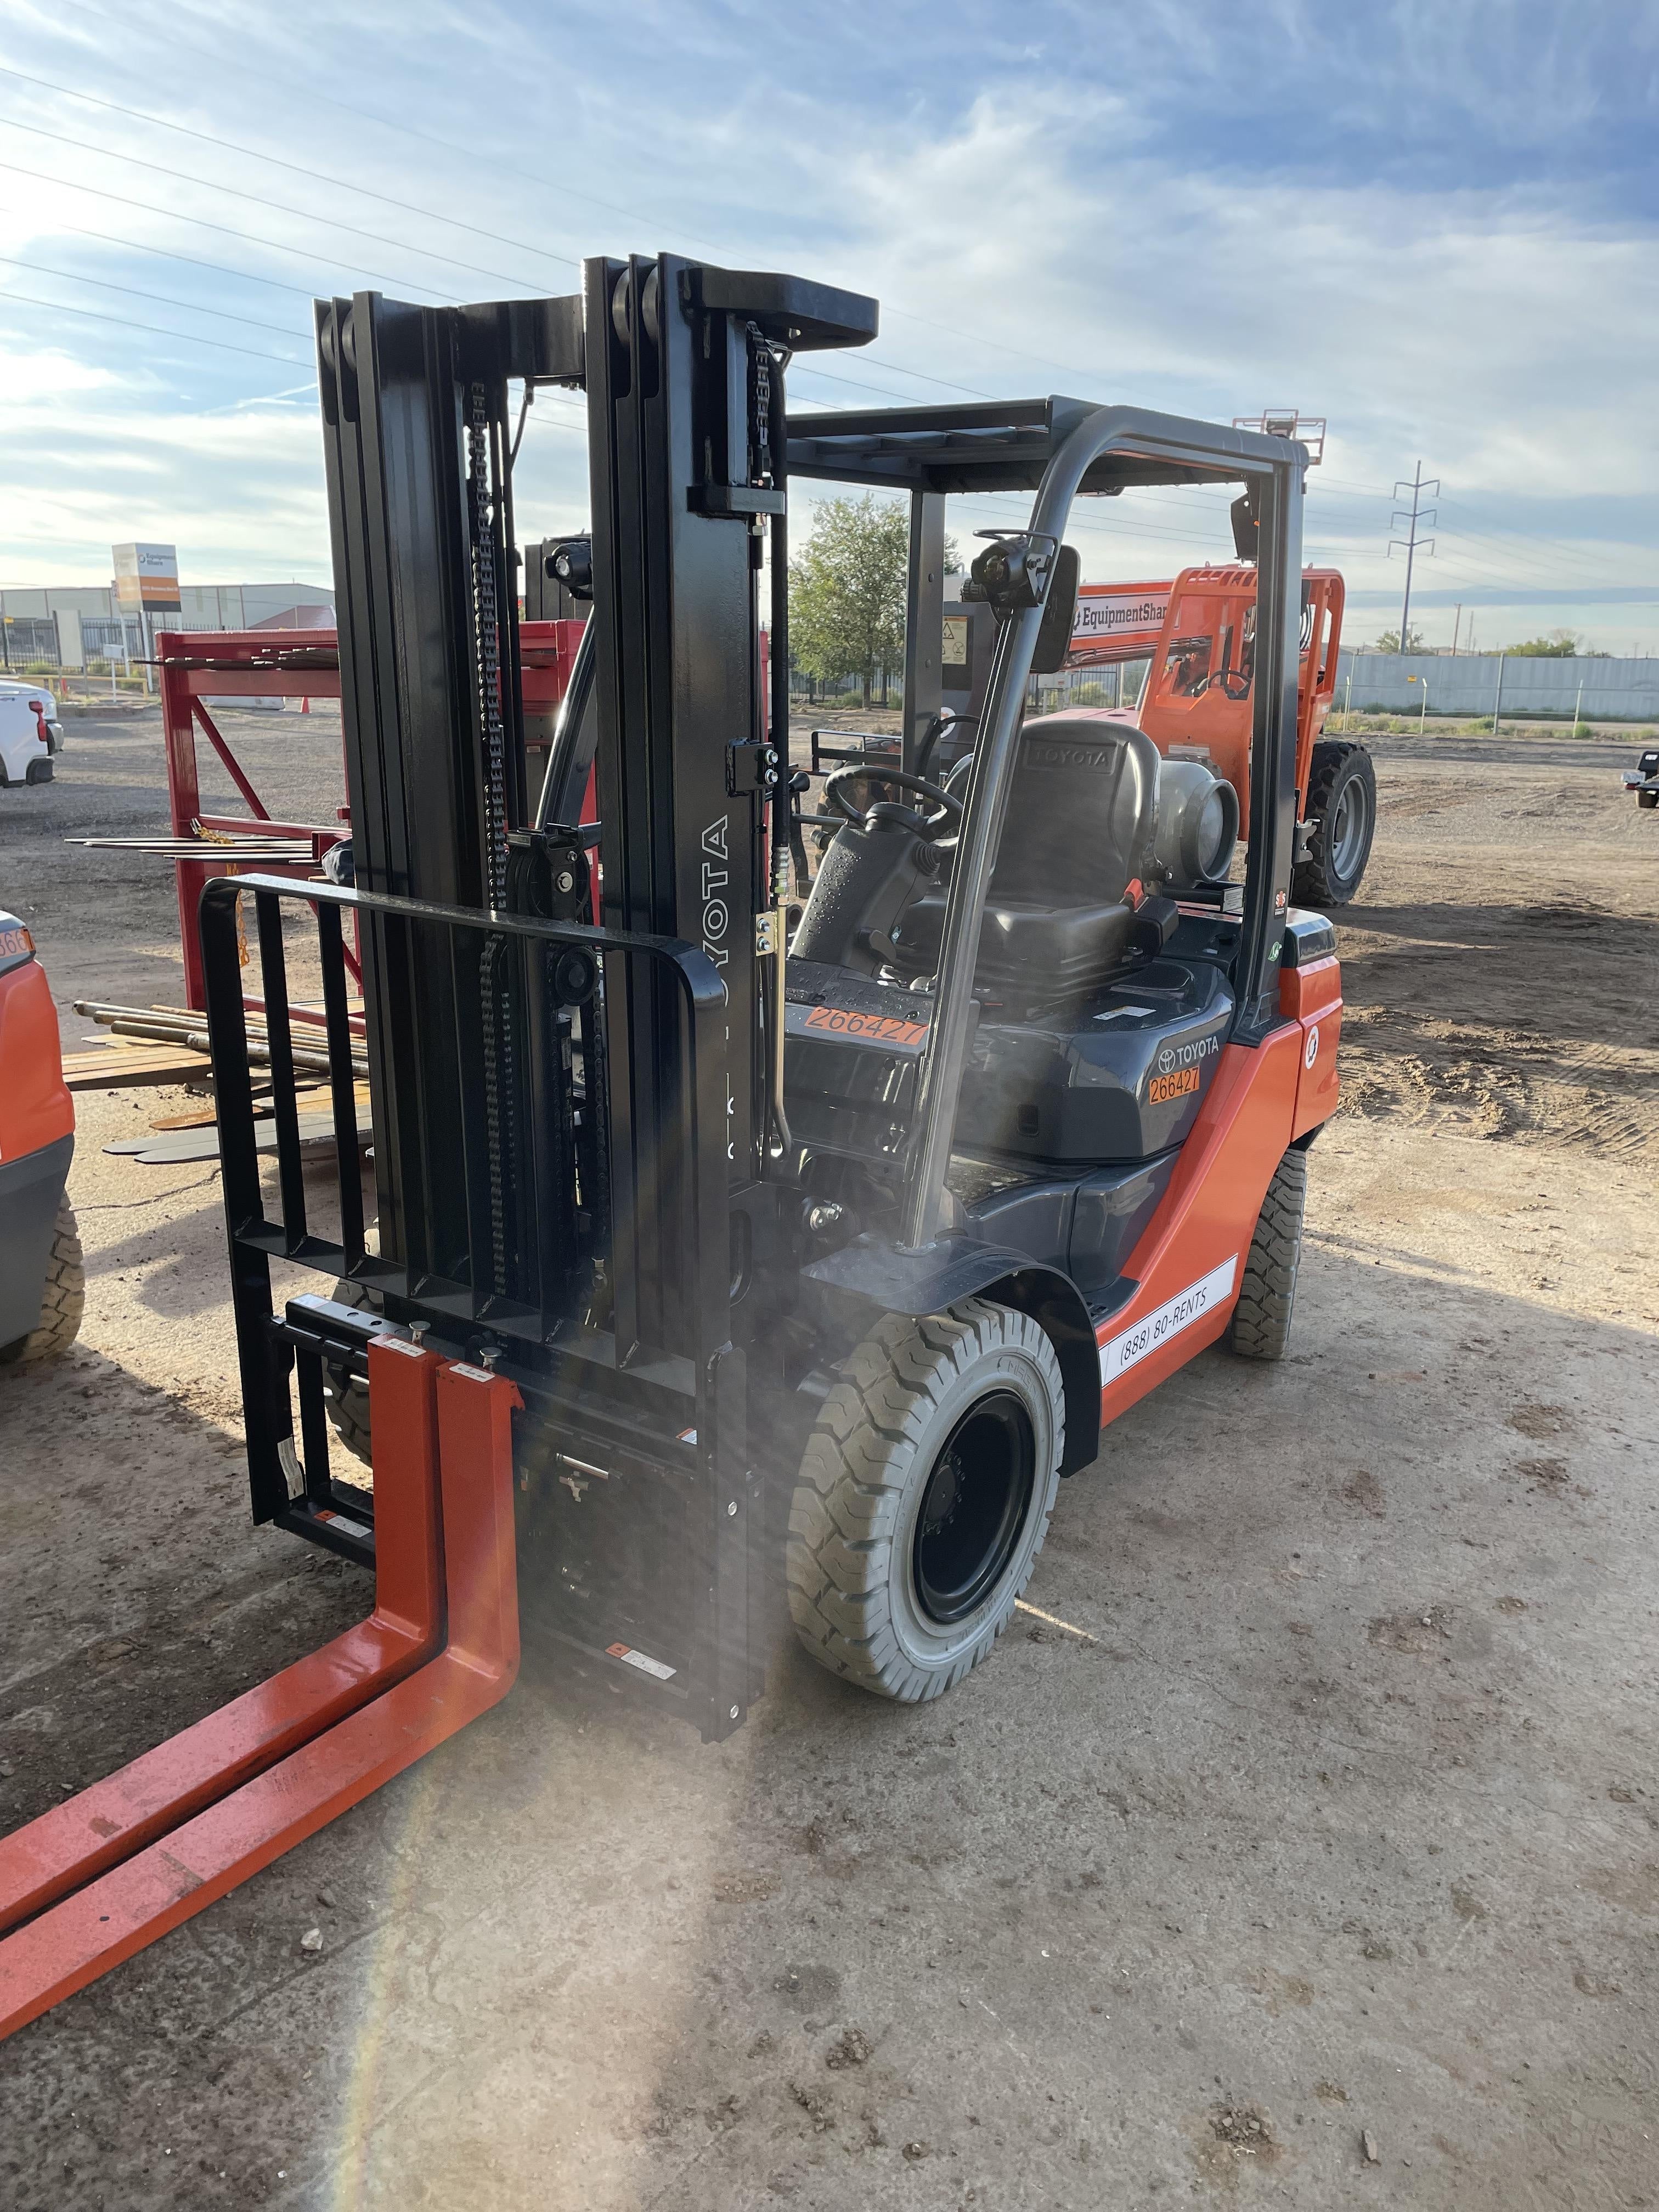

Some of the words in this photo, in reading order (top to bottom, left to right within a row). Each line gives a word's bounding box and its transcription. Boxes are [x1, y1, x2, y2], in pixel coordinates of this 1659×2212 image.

[1082, 603, 1167, 629] EquipmentShar
[1035, 748, 1108, 766] TOYOTA
[702, 814, 729, 1040] YOTA
[808, 1008, 928, 1041] 266427
[1177, 1036, 1219, 1065] TOYOTA
[1151, 1066, 1199, 1102] 266427
[1120, 1327, 1150, 1366] (888)
[1154, 1287, 1207, 1339] 80-RENTS
